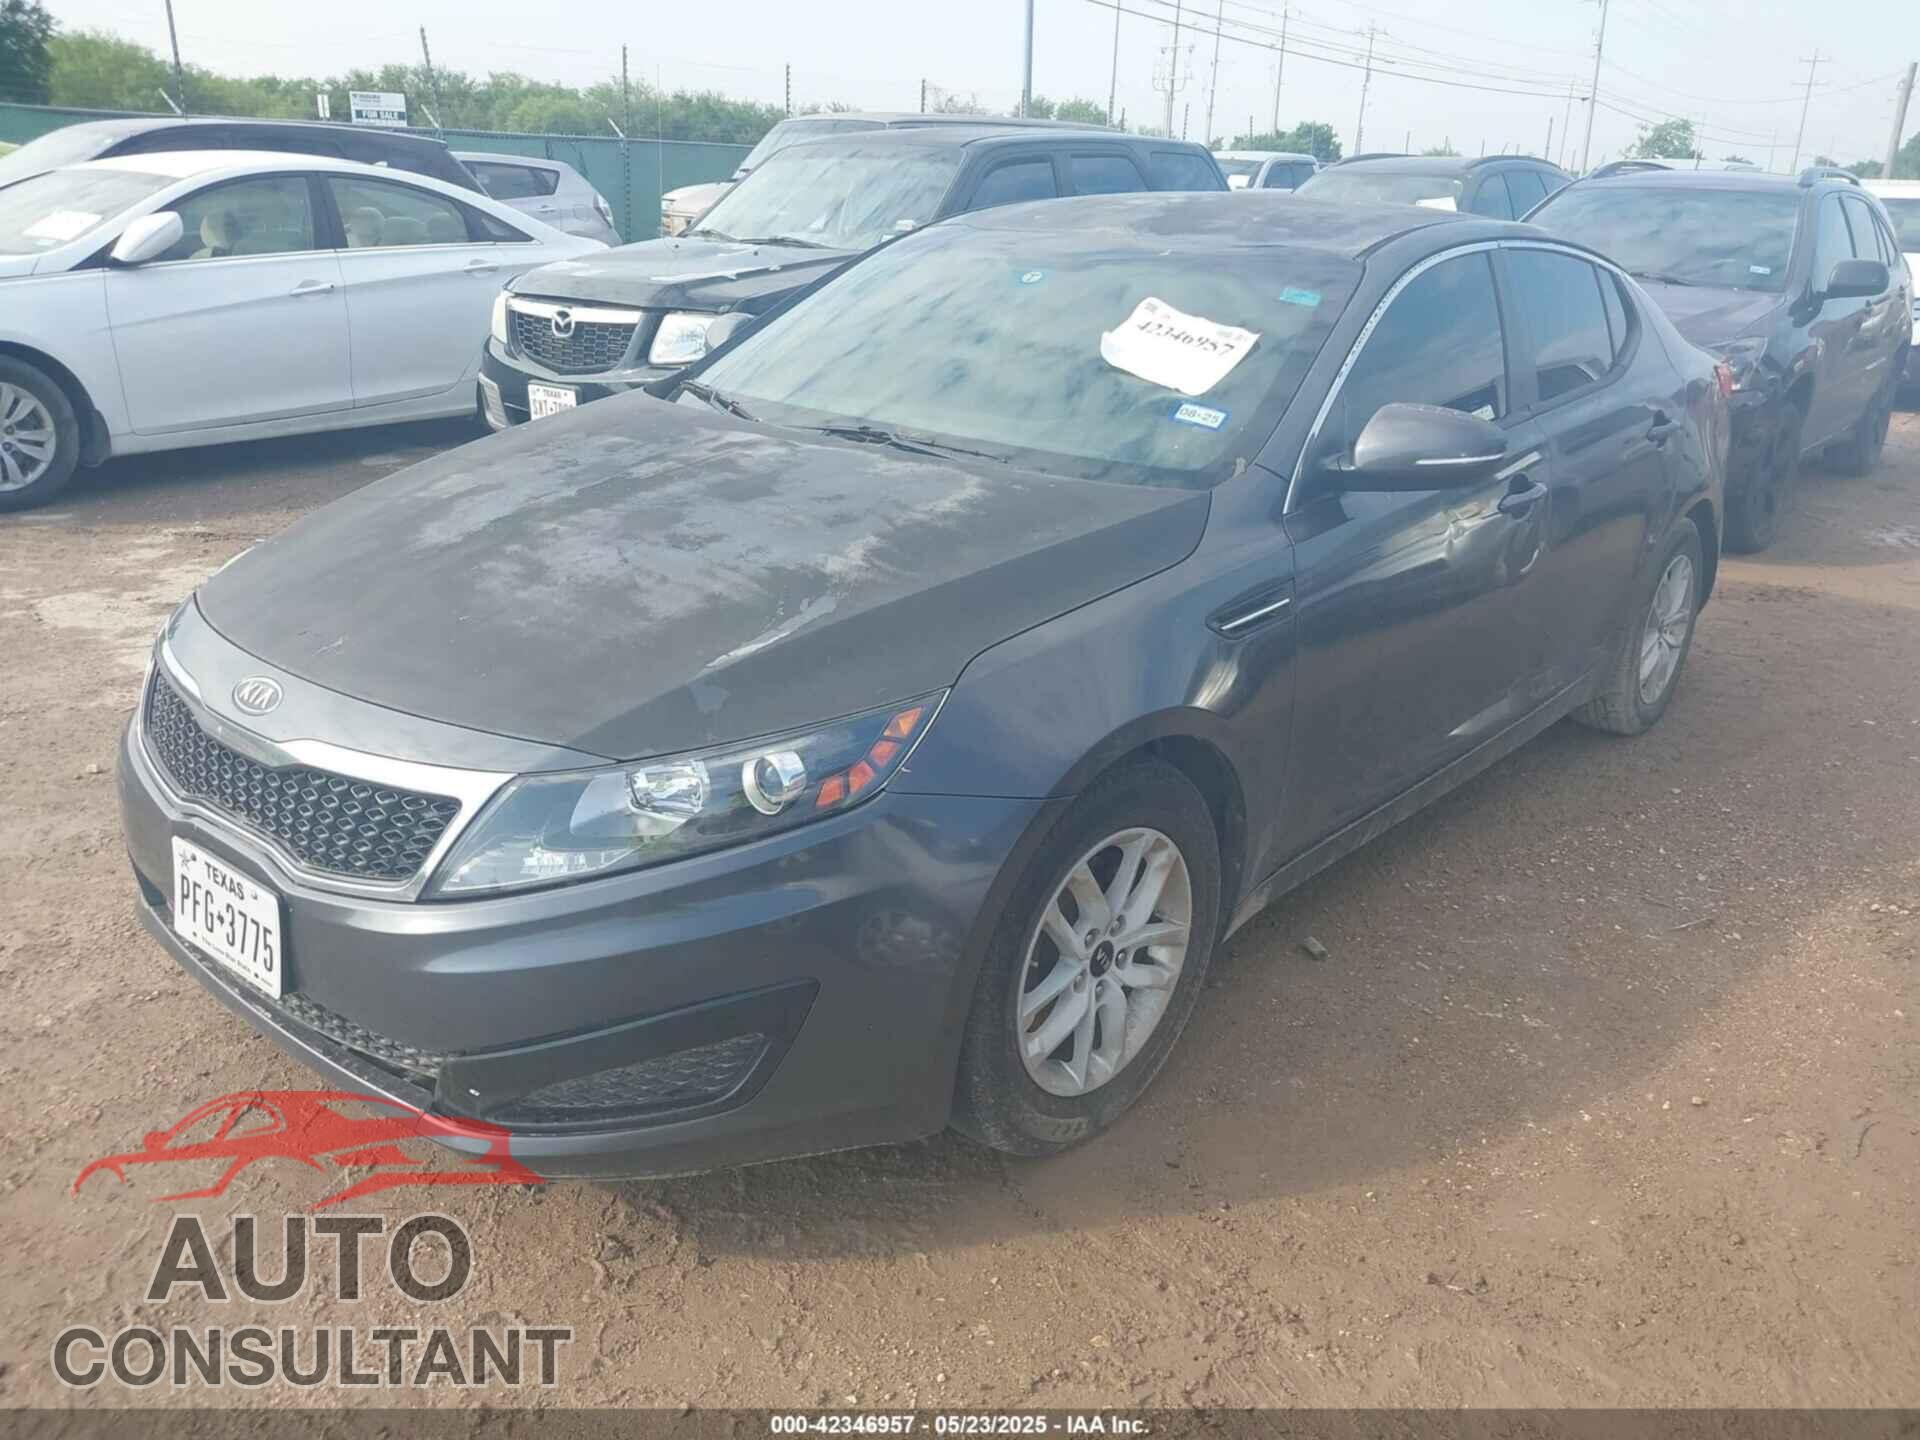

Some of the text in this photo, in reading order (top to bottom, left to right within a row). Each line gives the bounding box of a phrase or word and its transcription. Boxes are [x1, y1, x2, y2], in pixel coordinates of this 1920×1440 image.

[361, 110, 399, 120] FOR SALE
[204, 861, 245, 900] TEXAS
